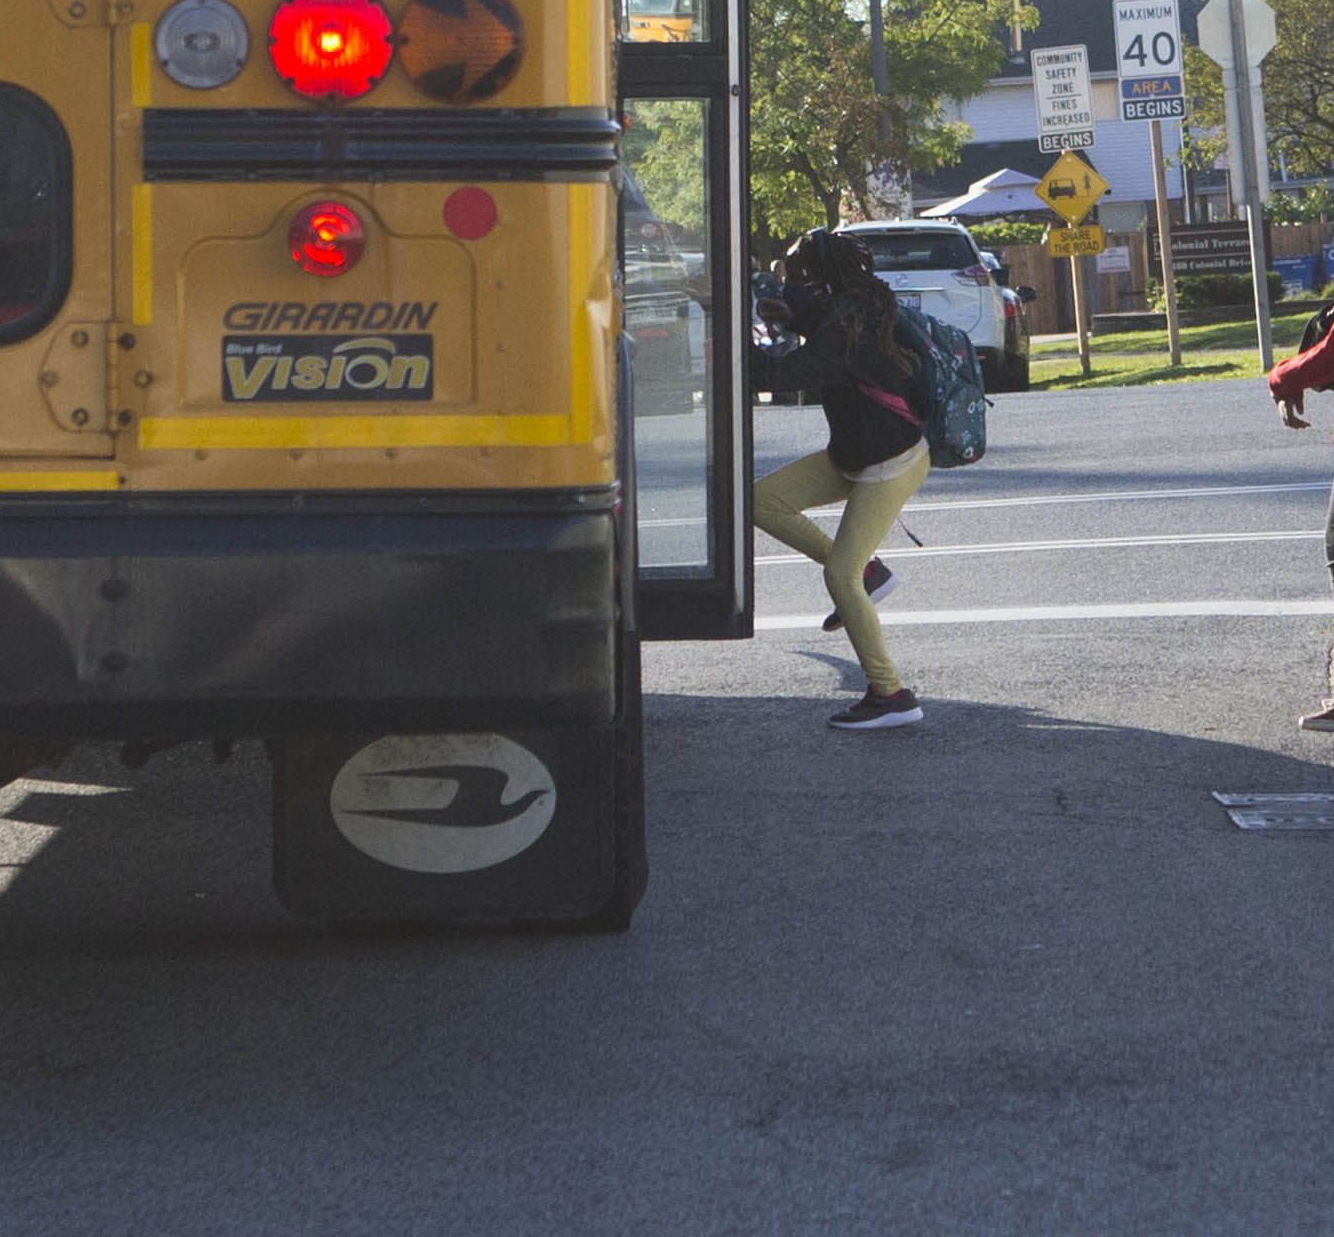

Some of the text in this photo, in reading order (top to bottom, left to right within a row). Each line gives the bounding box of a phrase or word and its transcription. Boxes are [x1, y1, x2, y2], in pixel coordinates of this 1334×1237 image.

[1119, 6, 1172, 21] MAXIMUM
[1123, 31, 1175, 67] 40
[1036, 52, 1082, 66] COMMUNITY
[1045, 67, 1077, 80] SAFETY
[1052, 82, 1074, 94] ZONE
[1132, 81, 1172, 95] AREA
[1052, 99, 1078, 111] FINES
[1126, 99, 1181, 118] BEGINS
[1042, 112, 1090, 126] INCREASED
[1042, 132, 1092, 150] BEGINS
[1060, 228, 1091, 242] SHARE
[1074, 241, 1100, 253] ROAD
[1171, 240, 1208, 250] olonial
[223, 302, 439, 330] GIRARDIN
